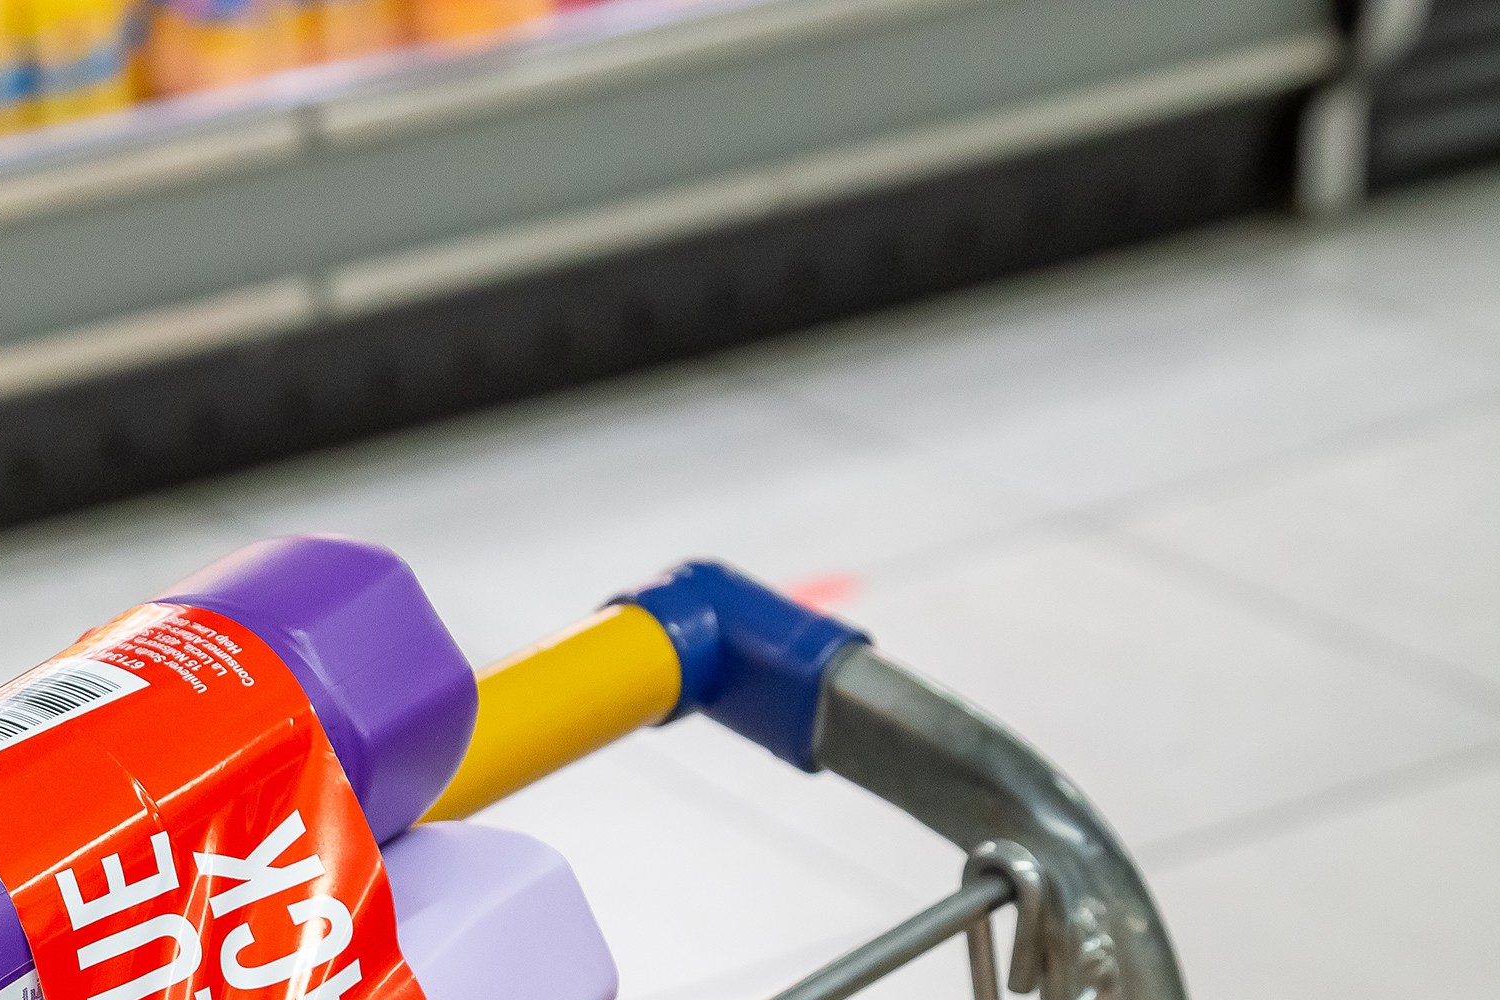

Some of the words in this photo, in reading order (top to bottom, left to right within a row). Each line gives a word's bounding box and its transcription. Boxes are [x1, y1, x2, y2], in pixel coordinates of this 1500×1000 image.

[215, 634, 243, 655] Help
[185, 658, 202, 671] 15
[211, 663, 228, 676] La
[164, 659, 208, 694] Unilever
